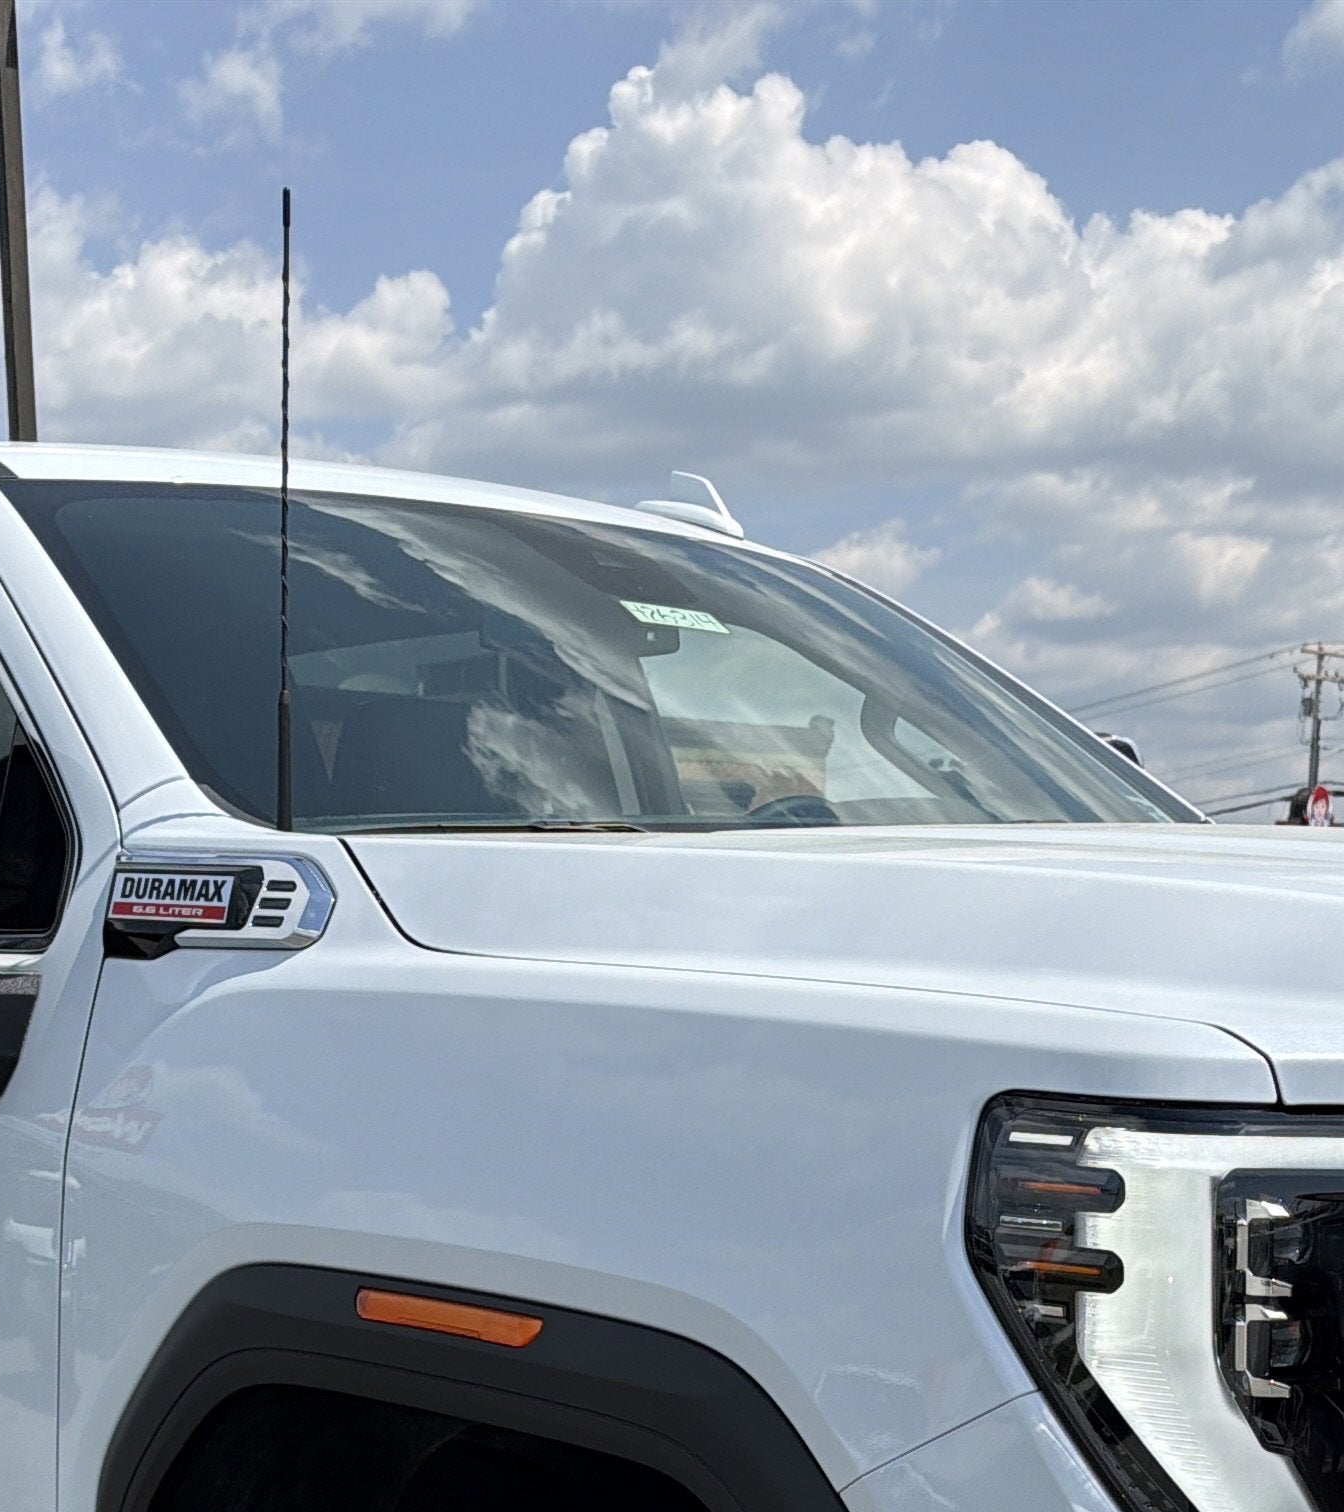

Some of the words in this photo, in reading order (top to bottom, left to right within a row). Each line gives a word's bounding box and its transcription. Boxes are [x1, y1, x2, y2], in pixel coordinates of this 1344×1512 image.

[120, 877, 227, 902] DURAMAX
[132, 905, 155, 913] 6.6
[159, 907, 203, 916] LITER
